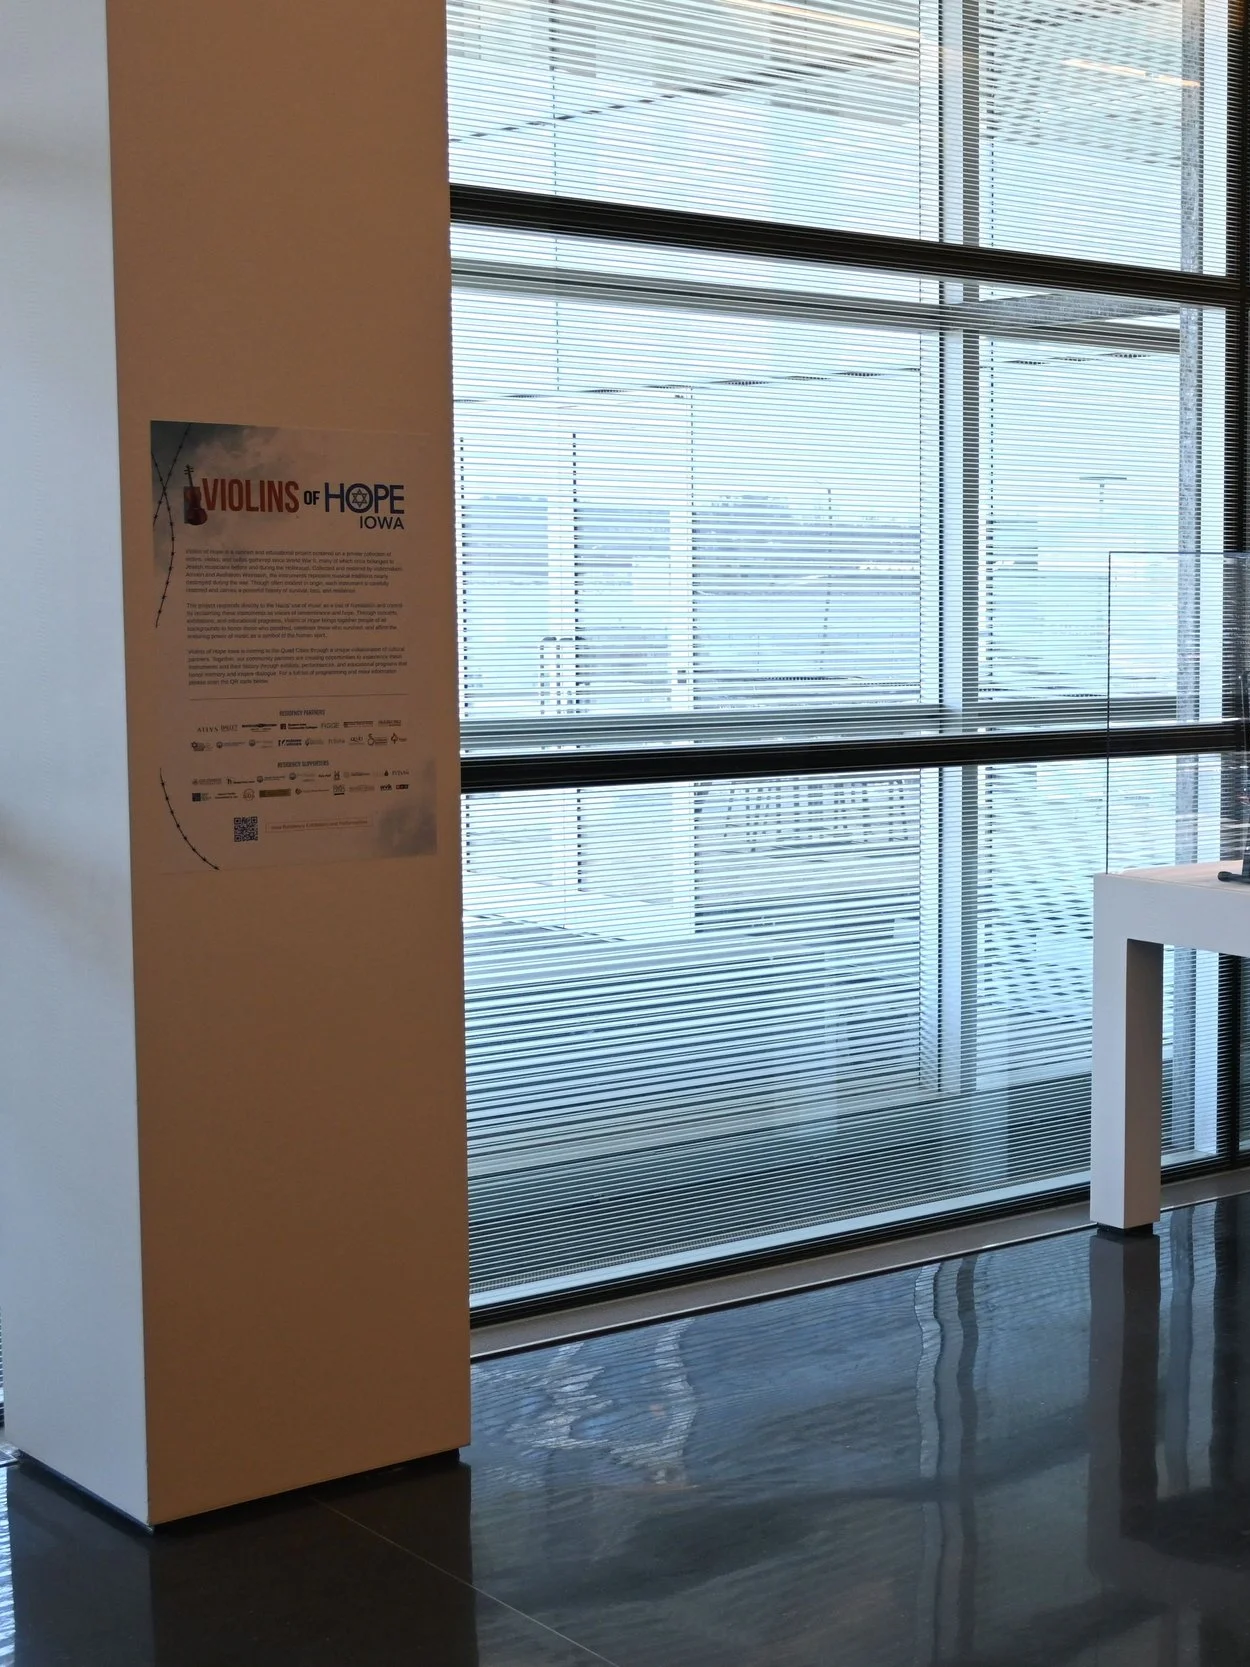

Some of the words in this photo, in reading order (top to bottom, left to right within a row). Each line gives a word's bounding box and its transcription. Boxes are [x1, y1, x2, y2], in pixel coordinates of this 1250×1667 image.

[202, 478, 300, 513] VIOLINS
[304, 490, 320, 505] OF
[325, 482, 404, 514] HOPE
[360, 516, 404, 530] IOWA
